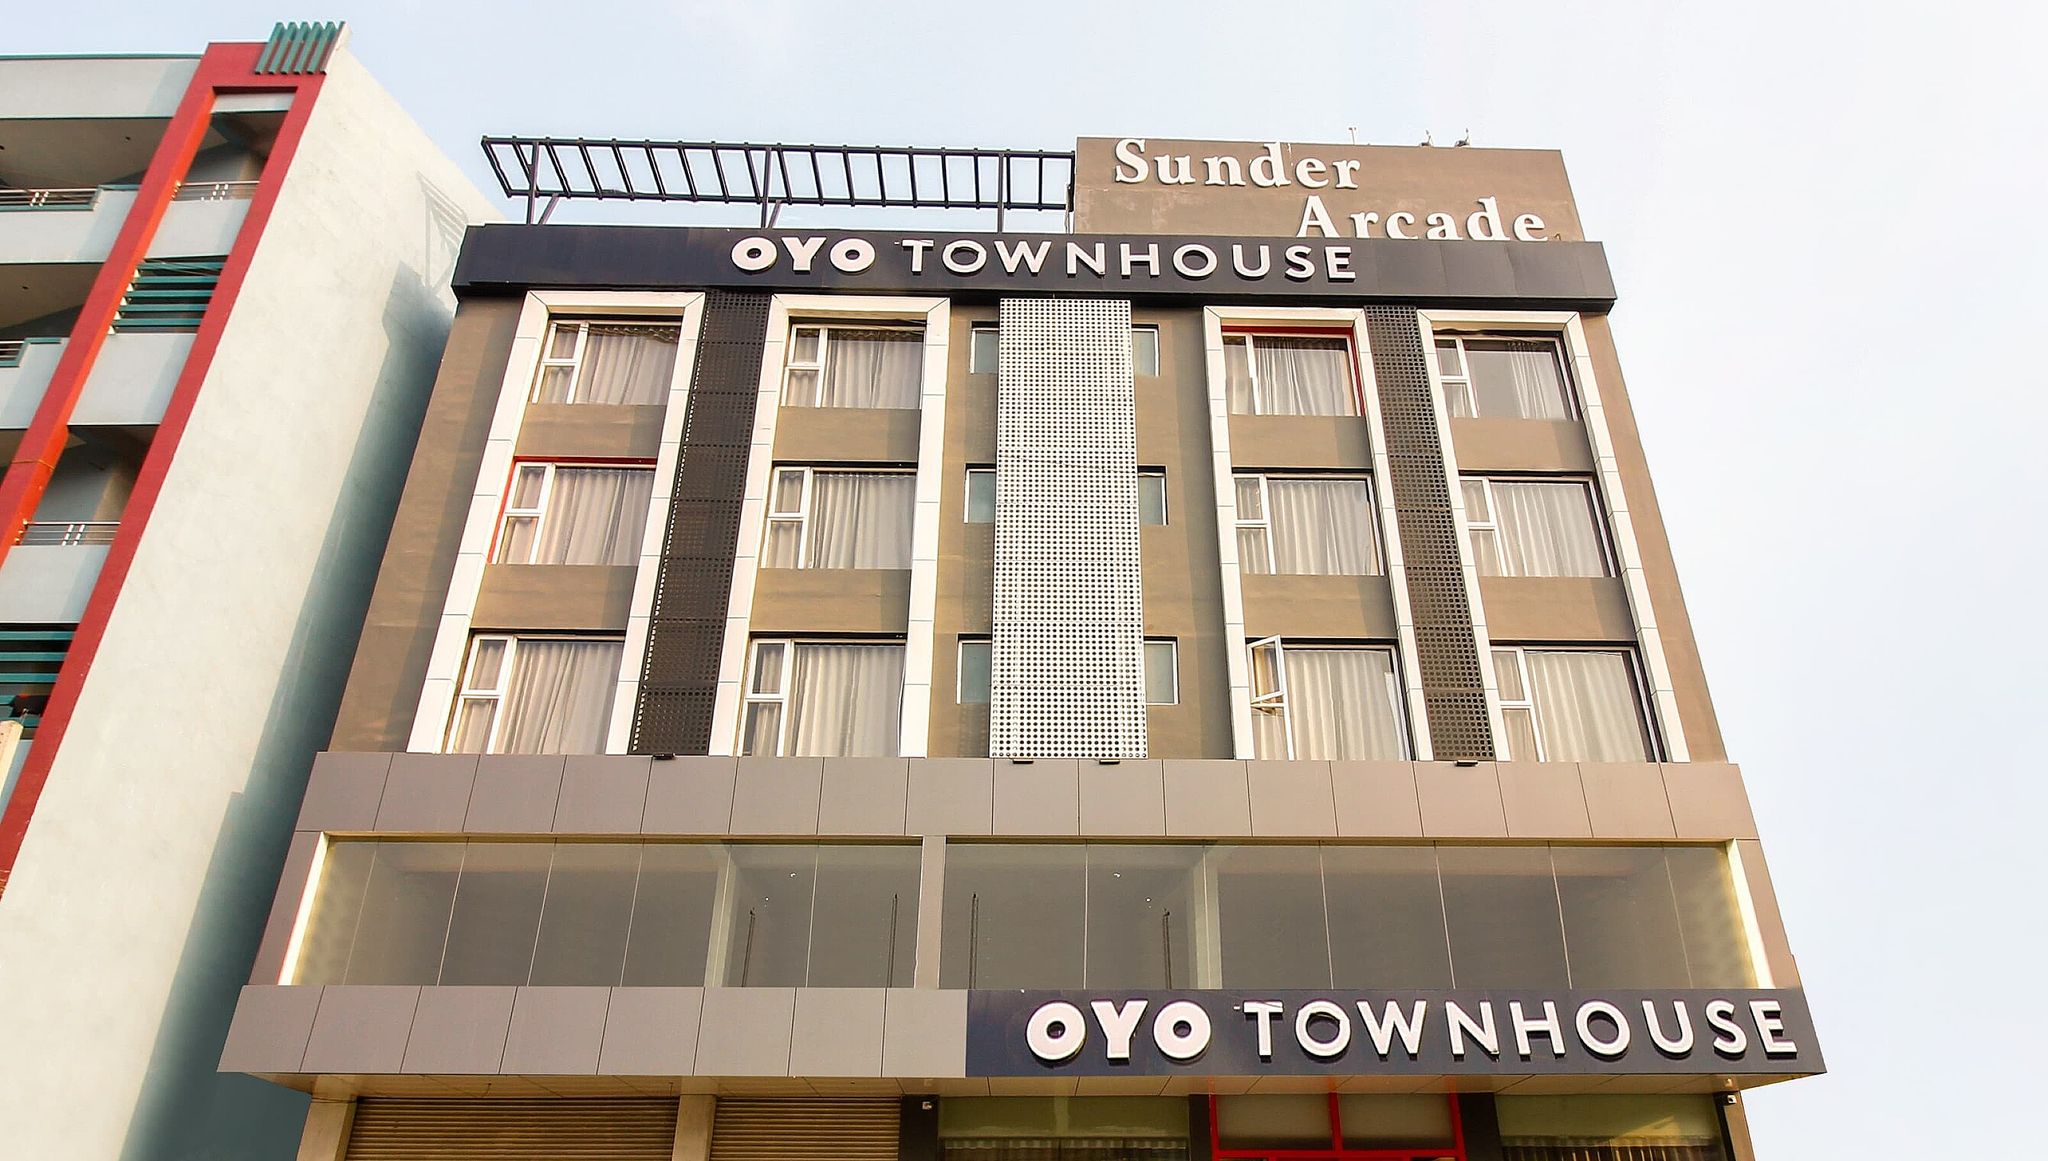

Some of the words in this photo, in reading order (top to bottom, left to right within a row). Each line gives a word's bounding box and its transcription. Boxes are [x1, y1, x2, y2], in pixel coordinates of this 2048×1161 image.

[1114, 138, 1361, 190] Sunder
[1296, 195, 1548, 242] Arcade
[731, 237, 876, 272] OYO
[903, 239, 1357, 280] TOWNHOUSE
[1025, 1001, 1211, 1061] OYO
[1243, 1000, 1798, 1058] TOWNHOUSE
